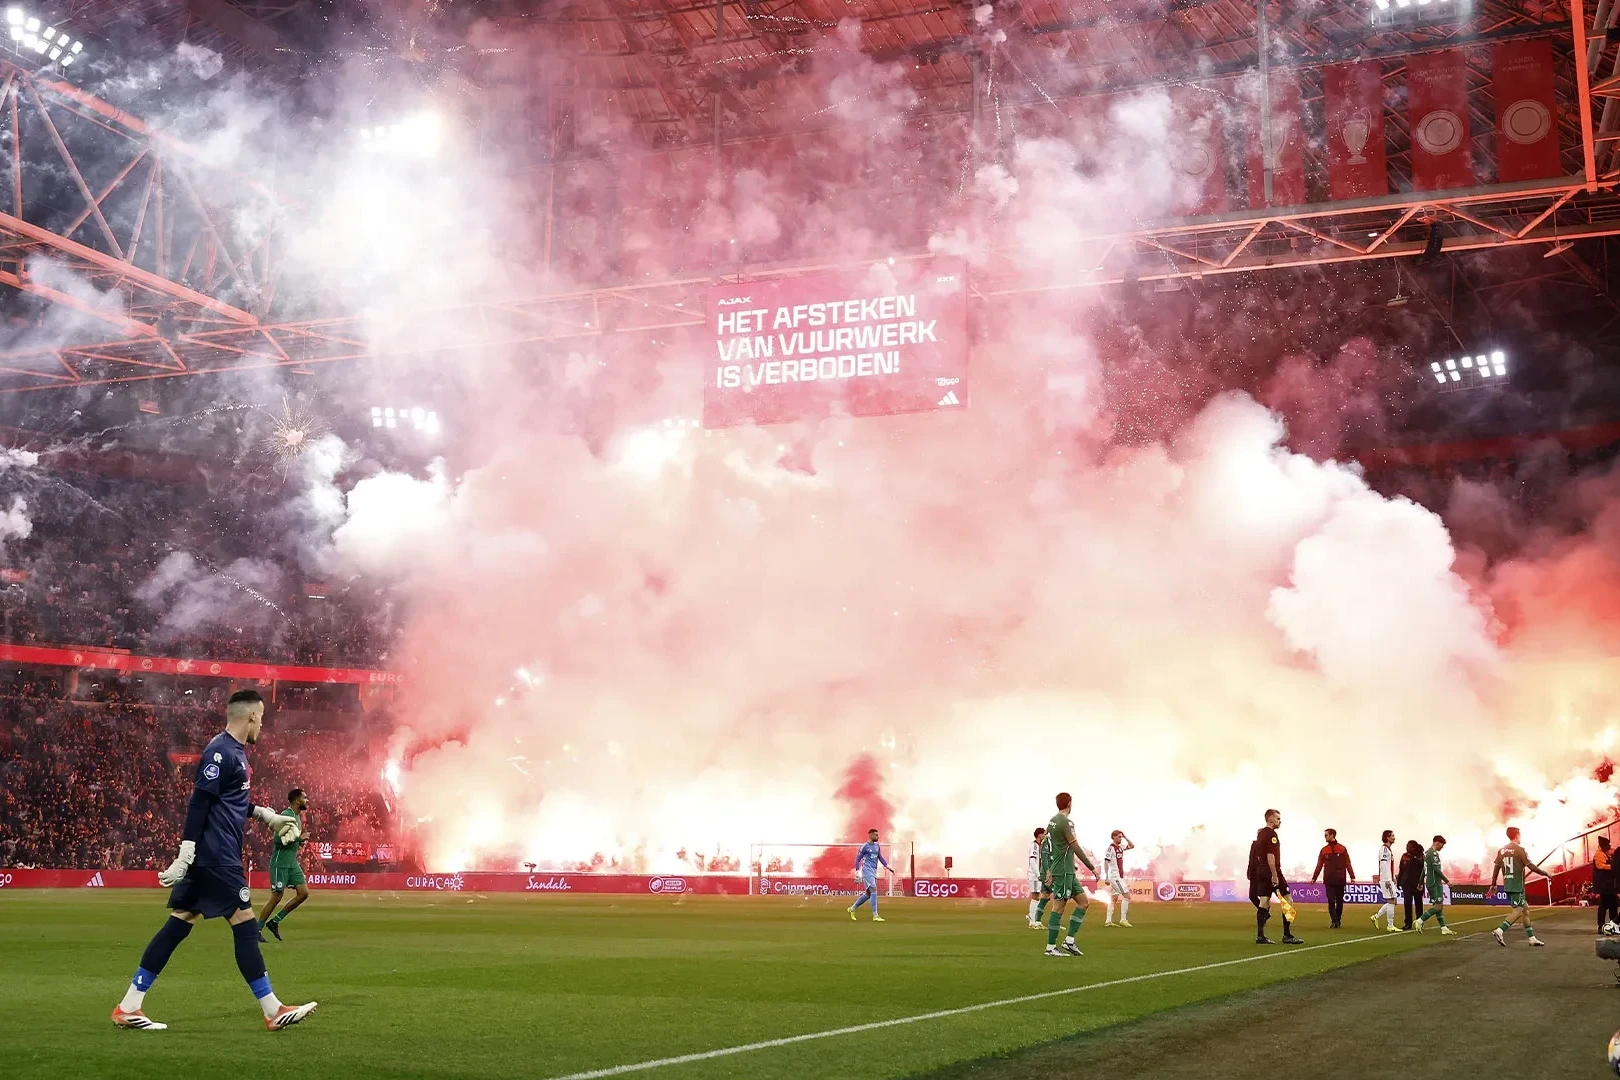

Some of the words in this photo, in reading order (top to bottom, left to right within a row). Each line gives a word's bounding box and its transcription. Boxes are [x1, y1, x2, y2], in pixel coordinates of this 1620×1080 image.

[718, 296, 751, 306] AJAX
[717, 308, 768, 335] HET
[773, 294, 915, 330] AFSTEKEN
[717, 335, 773, 361] VAN
[779, 319, 937, 356] VUURWERK
[717, 365, 741, 389] IS
[748, 351, 900, 386] VERBODEN!
[526, 876, 571, 890] Sandals
[774, 881, 829, 891] Coinmerce
[994, 883, 1031, 898] Zigg
[1343, 893, 1378, 903] OTERIJ
